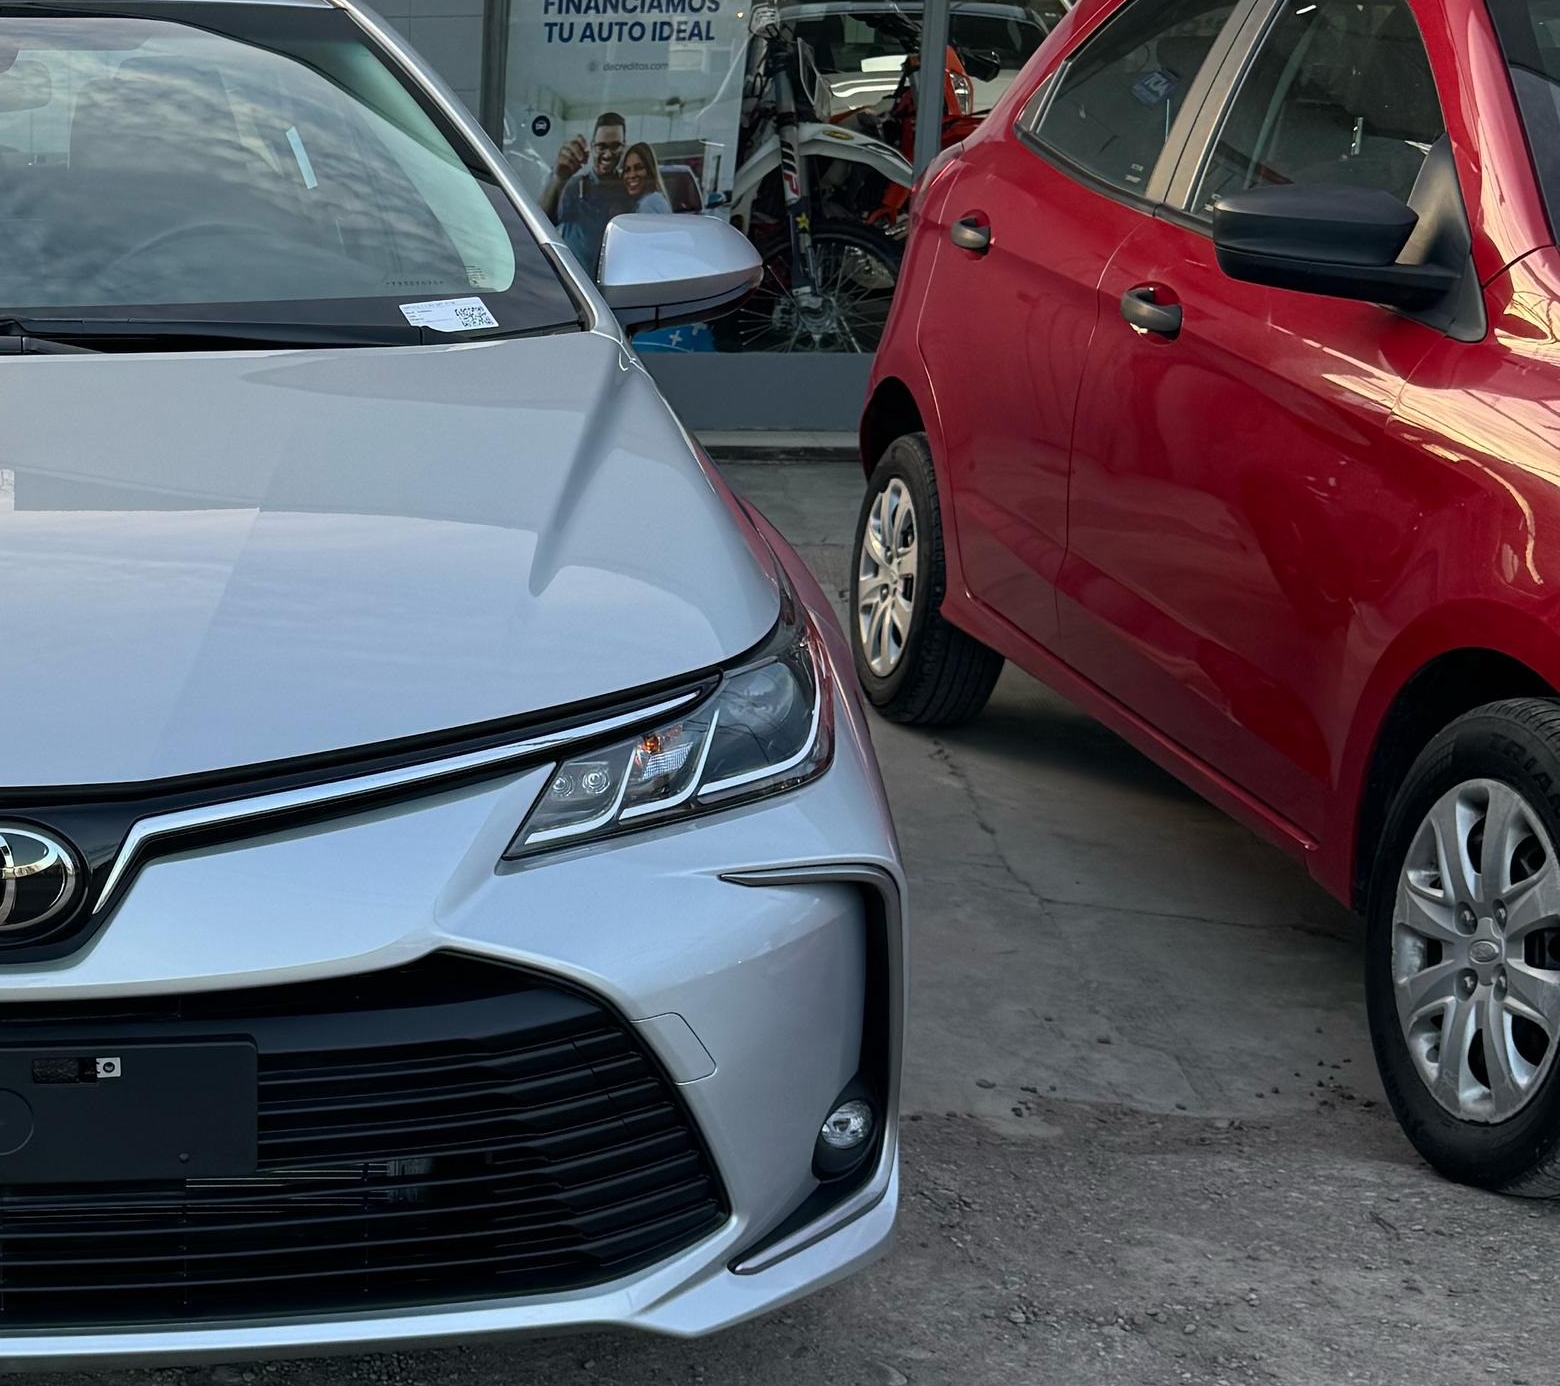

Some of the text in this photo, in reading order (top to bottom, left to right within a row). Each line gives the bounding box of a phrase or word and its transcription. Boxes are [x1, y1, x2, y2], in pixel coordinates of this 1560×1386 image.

[544, 20, 715, 43] TU AUTO IDEAL
